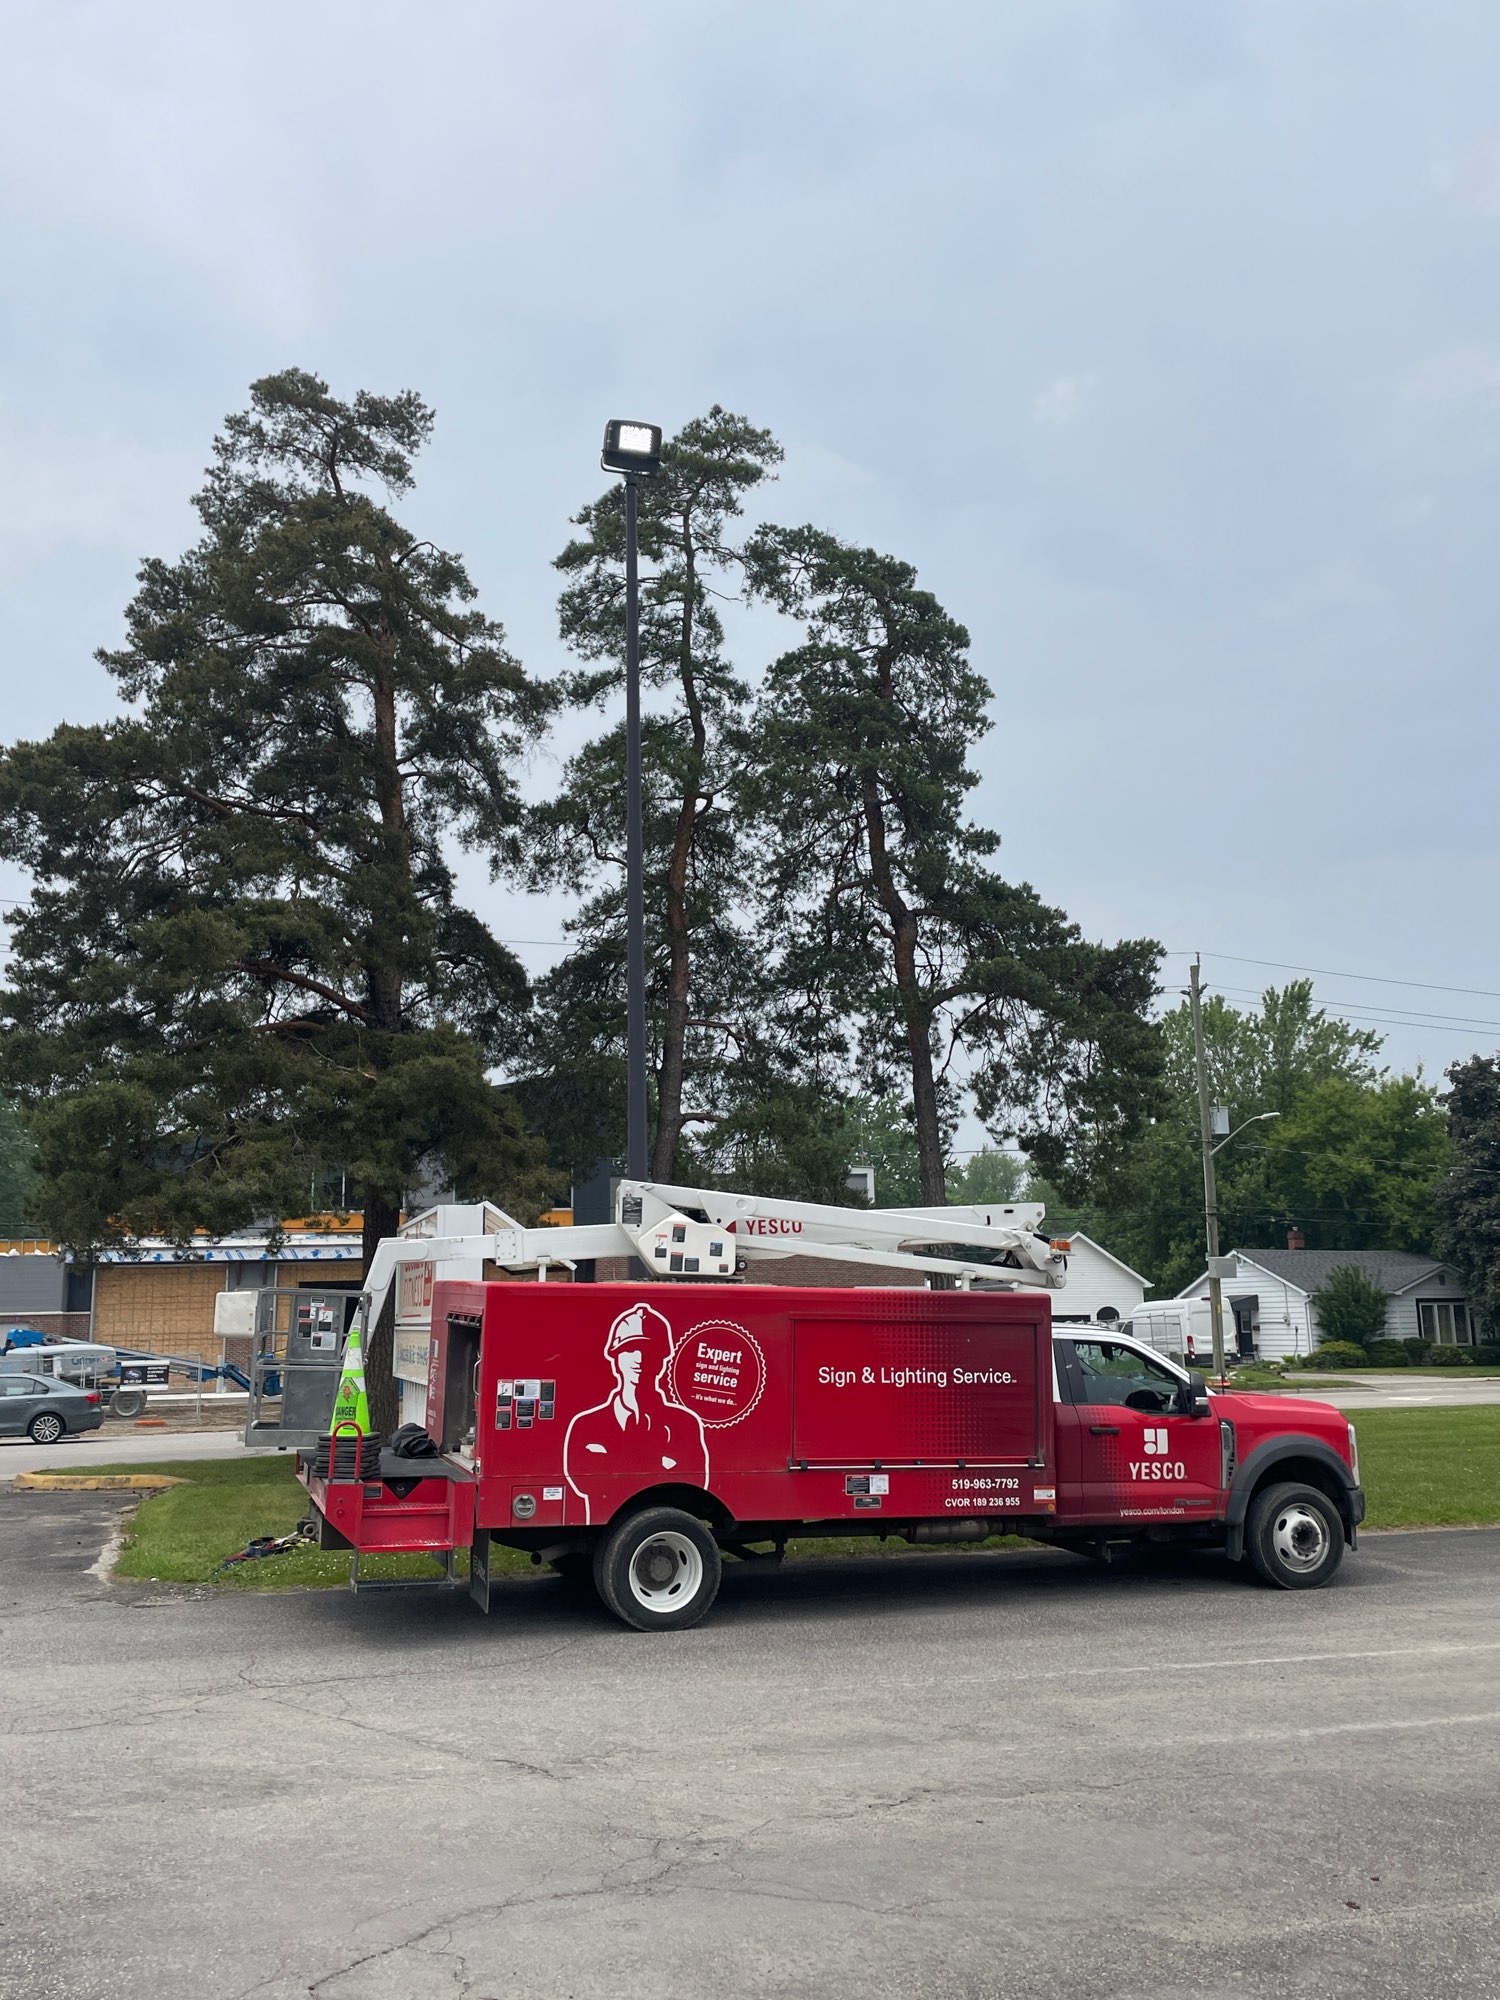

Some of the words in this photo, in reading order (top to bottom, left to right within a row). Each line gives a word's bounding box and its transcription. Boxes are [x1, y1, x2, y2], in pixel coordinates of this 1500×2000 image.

[745, 1218, 802, 1235] YESCO
[697, 1342, 742, 1364] Expert
[693, 1371, 738, 1388] service
[818, 1366, 856, 1388] Sign
[861, 1366, 876, 1384] &
[881, 1367, 947, 1388] Lighting
[1129, 1462, 1185, 1480] YESCO
[951, 1478, 1019, 1490] 519-963-7792
[944, 1498, 971, 1507] CVOR
[972, 1498, 987, 1506] 189
[988, 1498, 1004, 1506] 236
[1004, 1497, 1020, 1506] 955
[1120, 1506, 1185, 1517] yesco.com/london
